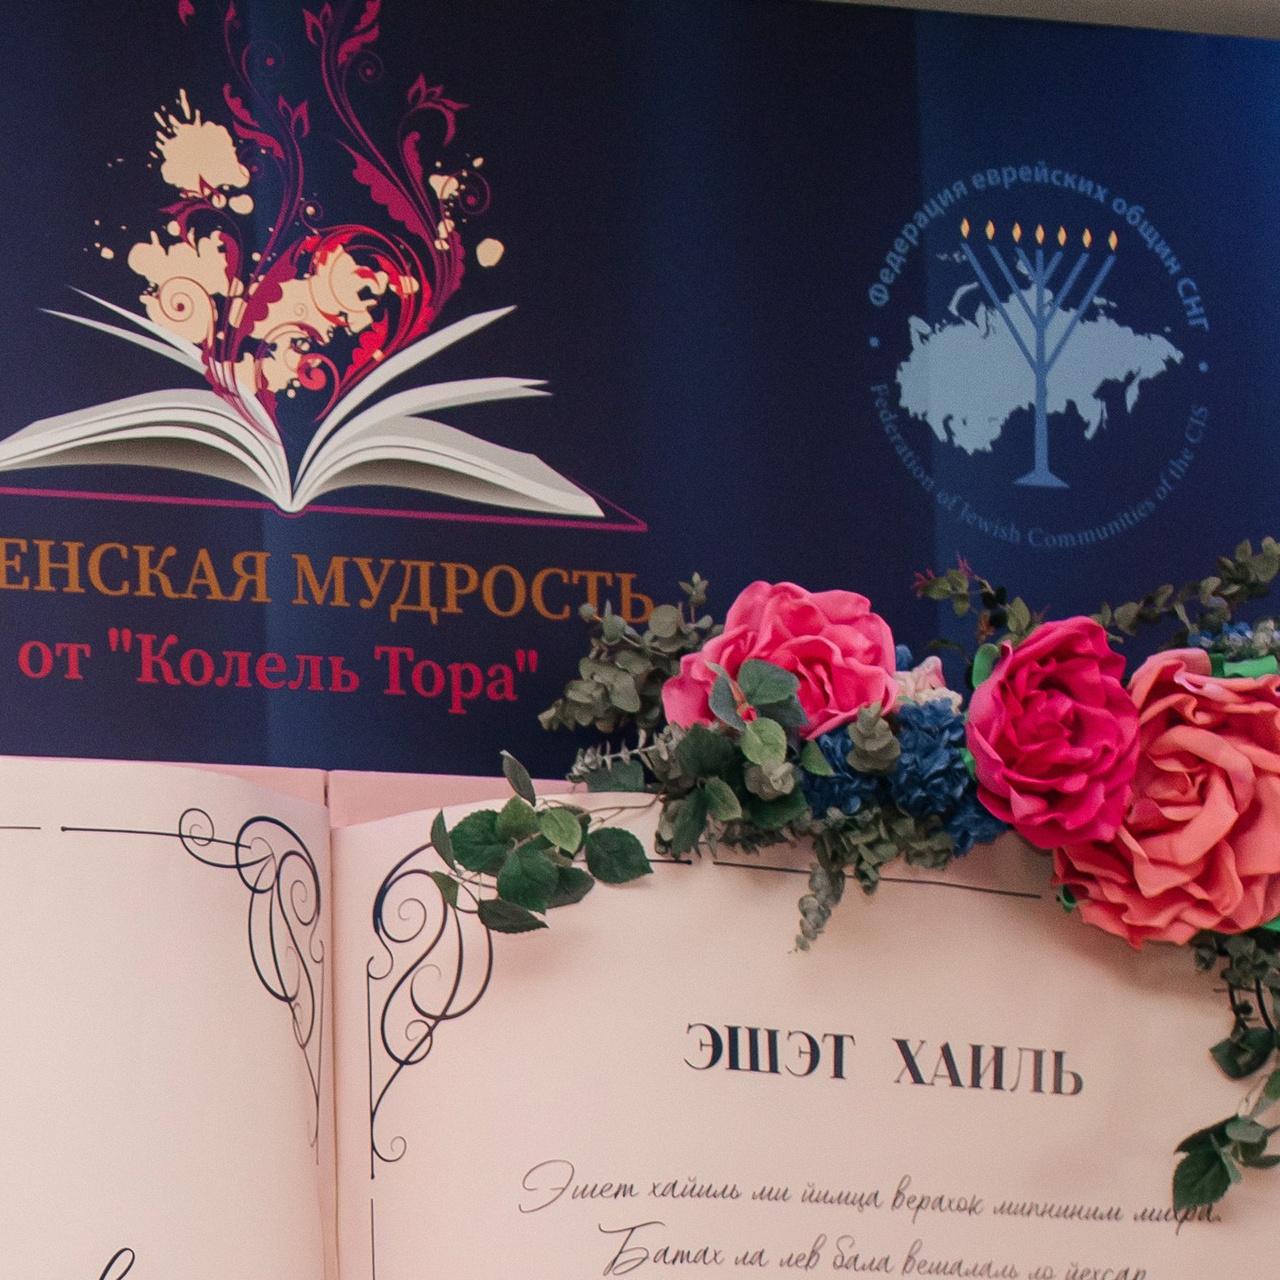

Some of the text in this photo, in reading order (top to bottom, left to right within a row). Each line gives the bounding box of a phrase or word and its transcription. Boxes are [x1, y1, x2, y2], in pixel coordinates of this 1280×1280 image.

[868, 162, 1210, 331] Федерация еврейских общин СНГ
[292, 553, 654, 625] МУДРОСТЬ
[19, 627, 538, 714] от "Колель Тора"
[684, 1022, 1084, 1096] ЭШЭТ ХАИЛЬ
[519, 1159, 984, 1223] Эшет хайиль йимца верахок
[599, 1221, 724, 1276] Батах
[779, 1233, 827, 1270] лев
[833, 1235, 894, 1272] бала
[901, 1239, 1019, 1279] вешалаль
